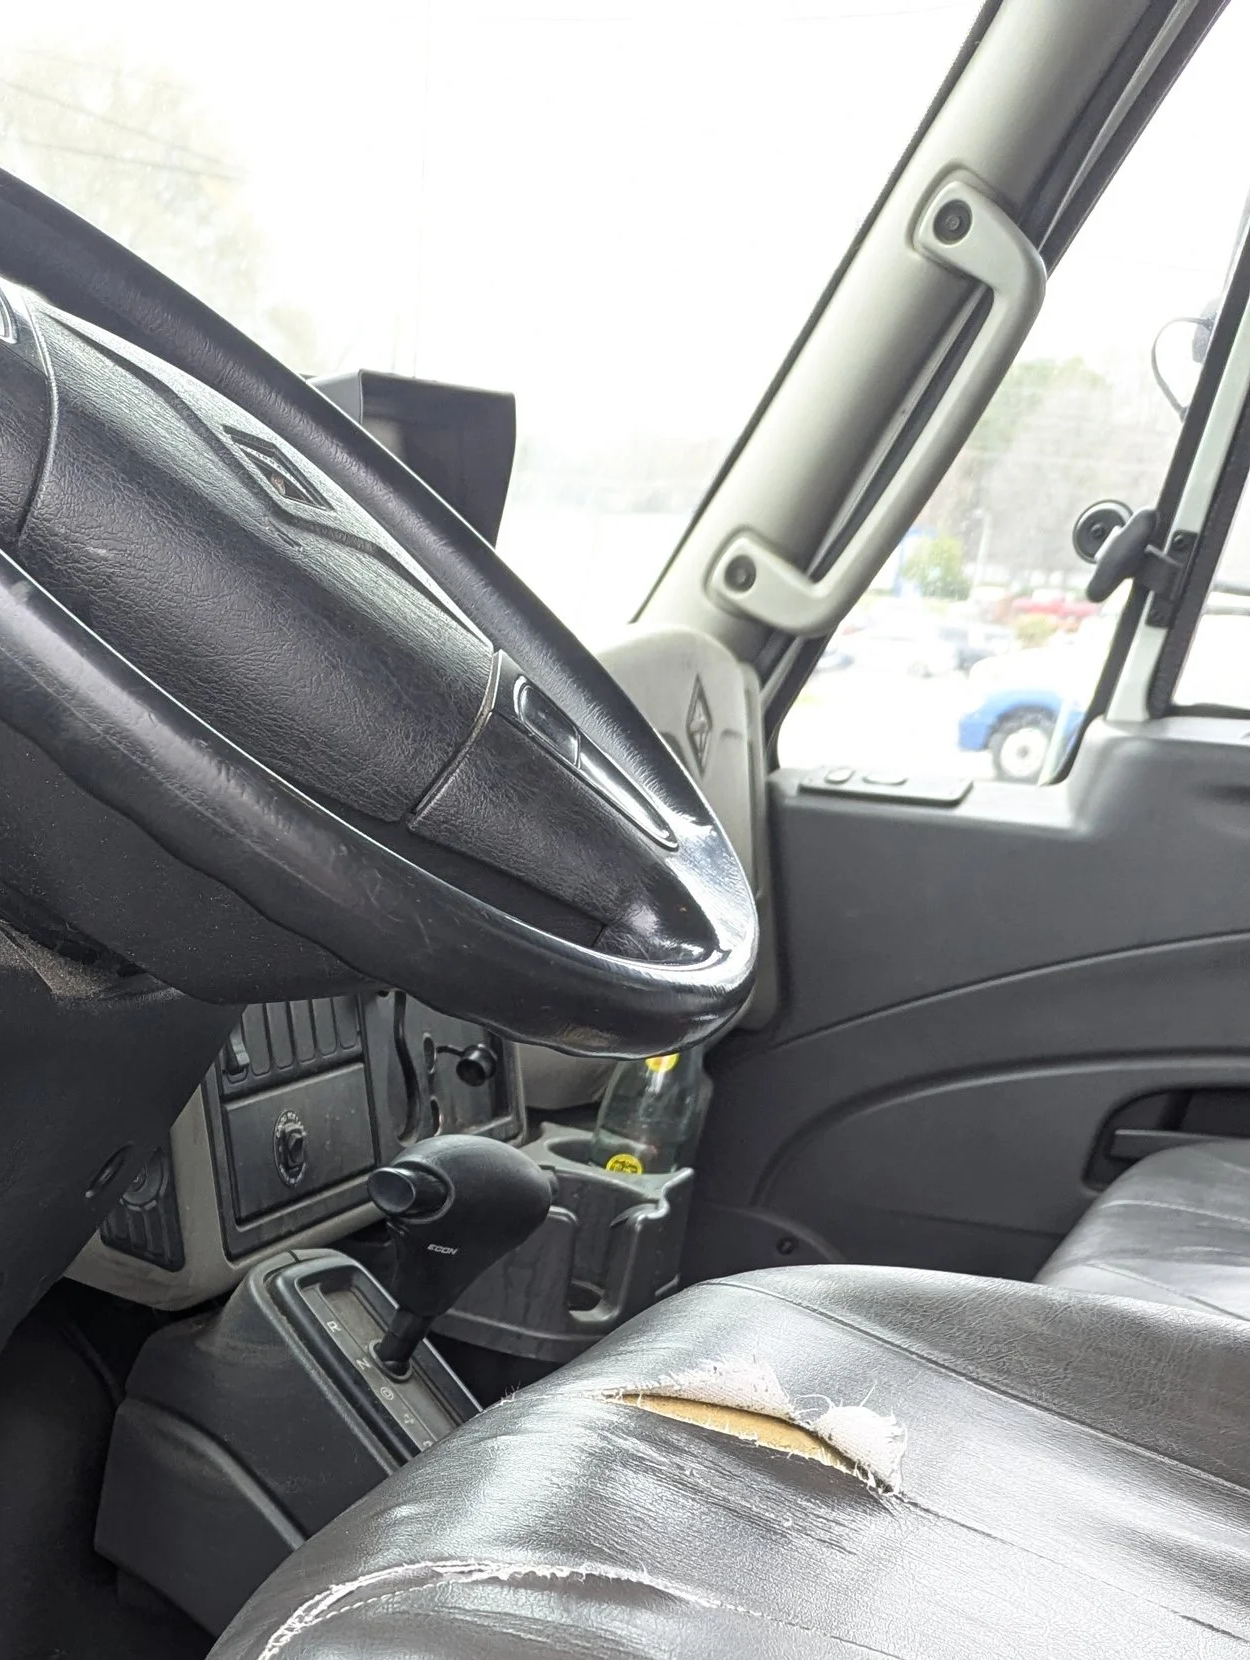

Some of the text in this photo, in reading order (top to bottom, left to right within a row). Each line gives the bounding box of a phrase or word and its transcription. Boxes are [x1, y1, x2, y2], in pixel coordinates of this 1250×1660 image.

[427, 1243, 458, 1255] ECON
[327, 1321, 341, 1333] R
[356, 1357, 371, 1370] N
